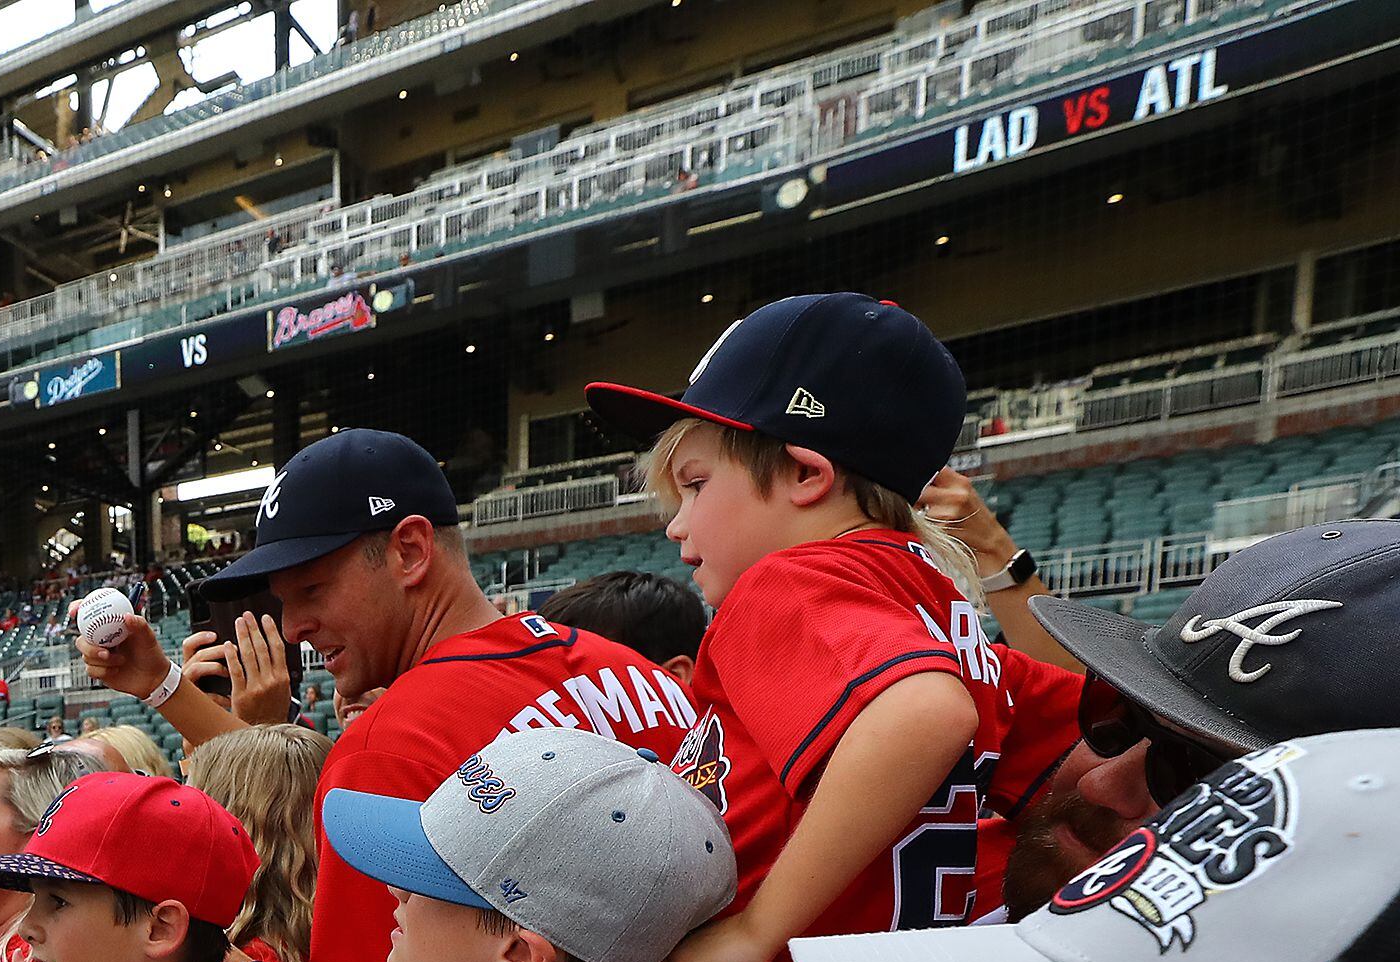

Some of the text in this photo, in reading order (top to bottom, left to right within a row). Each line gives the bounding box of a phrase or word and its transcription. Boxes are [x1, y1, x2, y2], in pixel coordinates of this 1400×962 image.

[953, 48, 1229, 173] LAD VS ATL
[180, 333, 208, 368] VS
[1142, 867, 1195, 908] 2021
